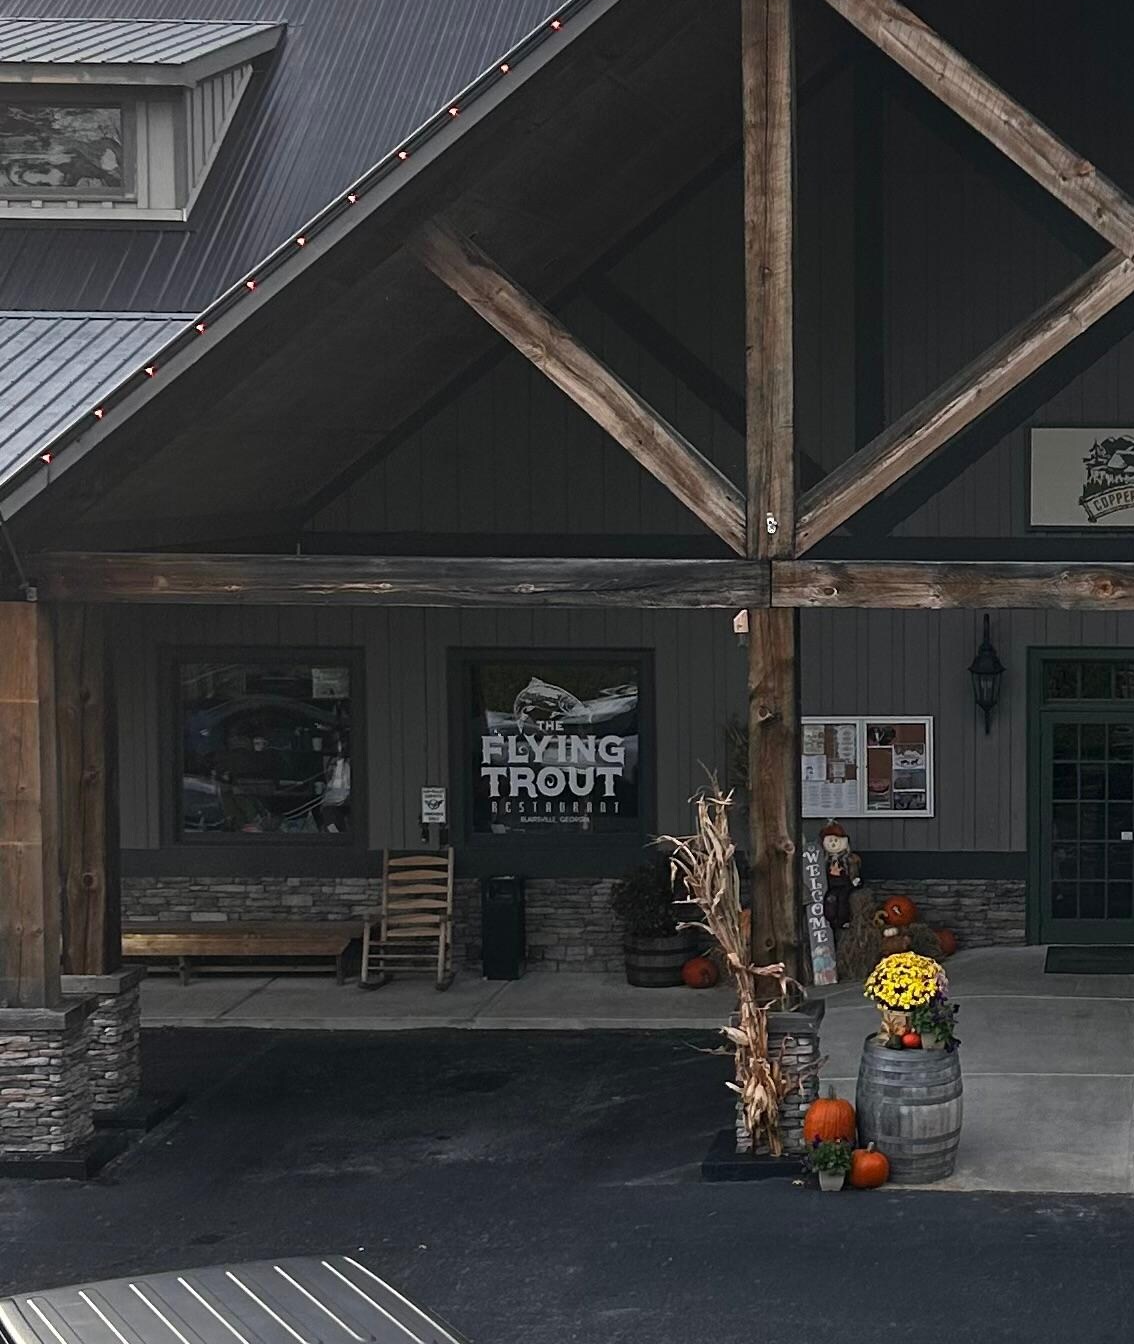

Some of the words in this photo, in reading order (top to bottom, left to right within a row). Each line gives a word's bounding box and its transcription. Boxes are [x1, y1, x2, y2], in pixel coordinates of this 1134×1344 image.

[536, 720, 565, 732] THE
[481, 734, 625, 766] FLYING
[481, 766, 623, 798] TROUT
[491, 801, 620, 814] RESTAURANT
[802, 849, 829, 944] WELCOME
